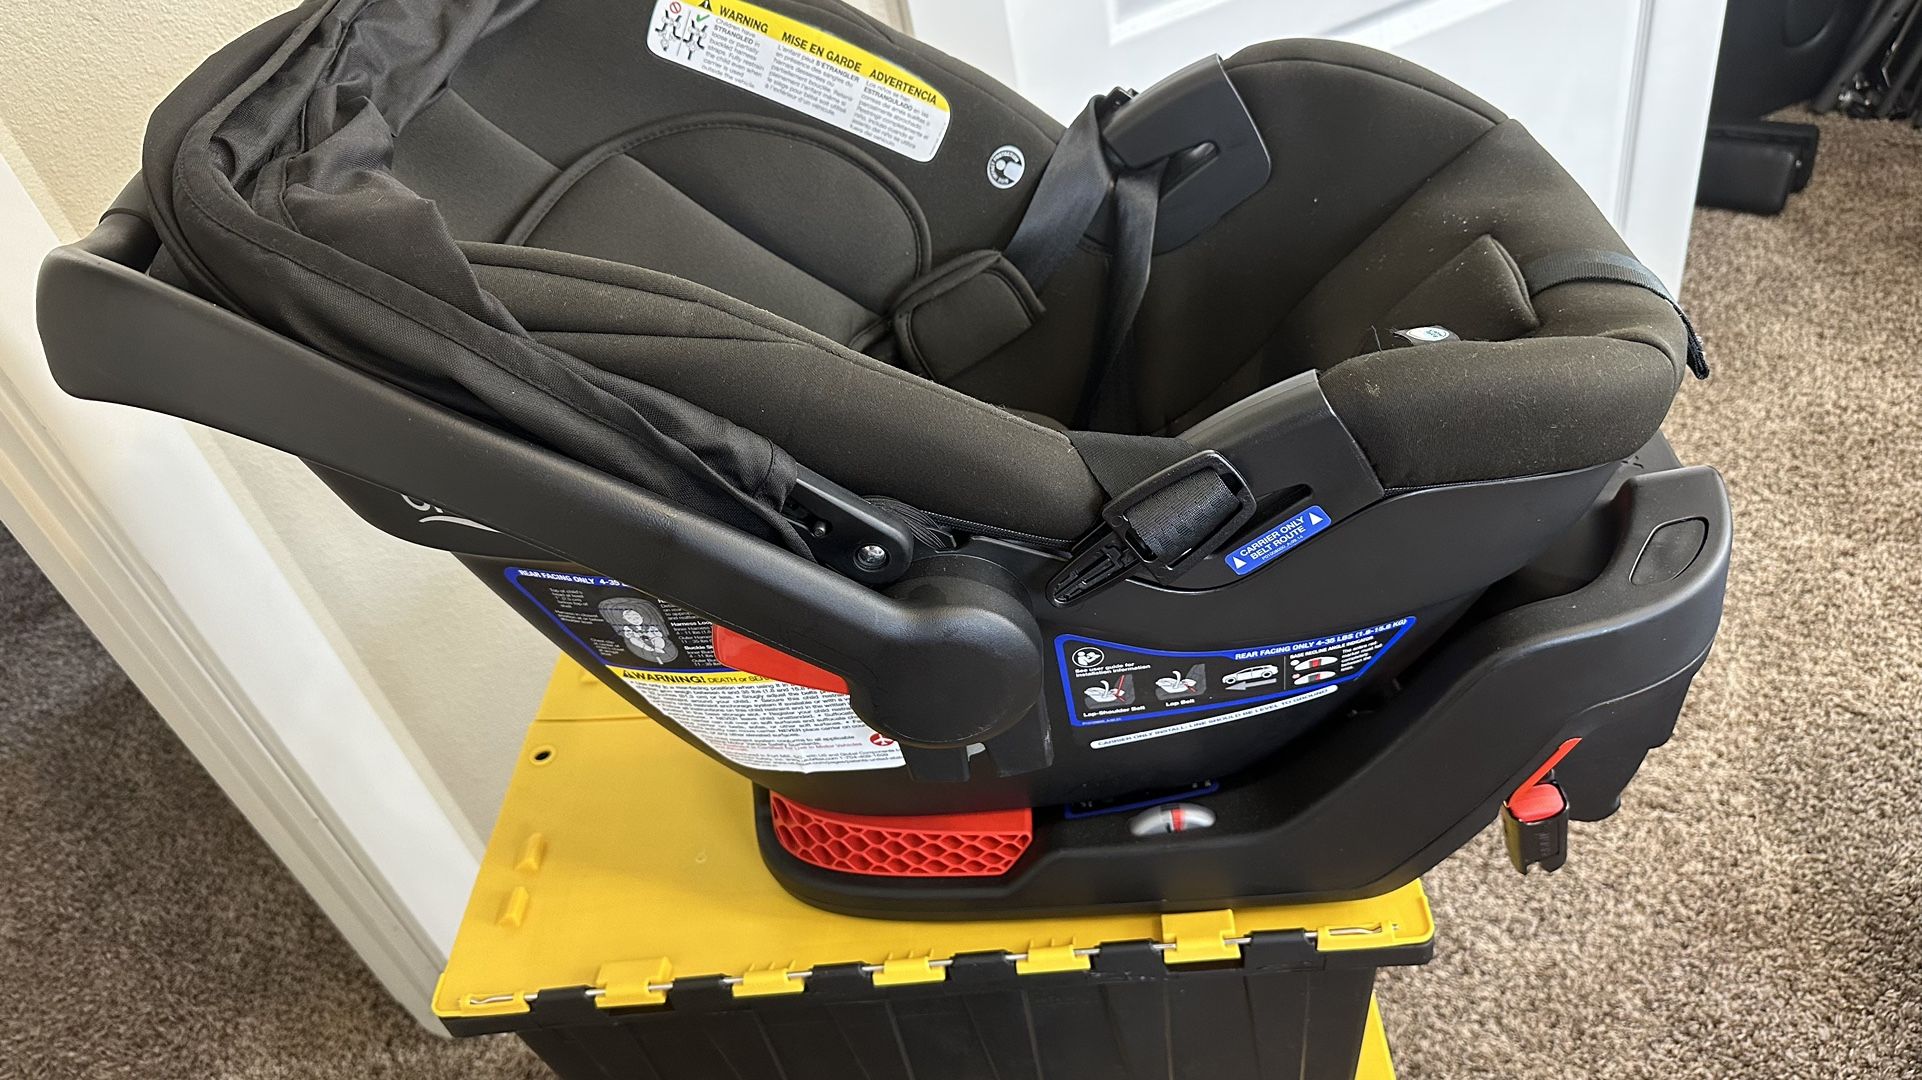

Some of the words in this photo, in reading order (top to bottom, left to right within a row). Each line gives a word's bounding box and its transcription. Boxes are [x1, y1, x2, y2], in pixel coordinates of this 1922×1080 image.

[715, 18, 741, 32] Children
[741, 28, 757, 38] have
[718, 6, 770, 34] WARNING
[711, 31, 728, 42] loose
[735, 41, 760, 55] partially
[713, 25, 754, 45] STRANGLED
[709, 38, 733, 51] buckled
[733, 48, 757, 61] harness
[781, 32, 809, 50] MISE
[809, 43, 825, 57] EN
[825, 50, 862, 73] GARDE
[701, 64, 723, 76] outside
[703, 58, 722, 69] carrier
[729, 68, 745, 78] used
[705, 51, 716, 59] the
[716, 55, 731, 65] child
[731, 62, 746, 71] even
[746, 68, 762, 77] when
[727, 53, 742, 63] Fully
[742, 59, 765, 72] restrain
[810, 66, 822, 74] des
[869, 68, 939, 105] ADVERTENCIA
[863, 86, 913, 112] ESTRANGULADO
[1238, 530, 1281, 558] CARRIER
[1279, 515, 1306, 535] ONLY
[1249, 543, 1273, 561] BELT
[1272, 524, 1307, 548] ROUTE
[518, 569, 542, 578] REAR
[542, 572, 573, 582] FACING
[573, 576, 595, 585] ONLY
[1234, 650, 1259, 661] REAR
[1259, 645, 1291, 657] FACING
[1292, 641, 1315, 651] ONLY
[1337, 634, 1354, 642] LBS
[1327, 643, 1346, 651] ANGLE
[1346, 637, 1374, 647] INDICATOR
[633, 672, 706, 683] WARNING!
[707, 675, 737, 683] DEATH
[1113, 665, 1151, 673] information
[1083, 707, 1130, 718] Lap-Shoulder
[1097, 736, 1132, 746] CARRIER
[1189, 720, 1207, 728] LINE
